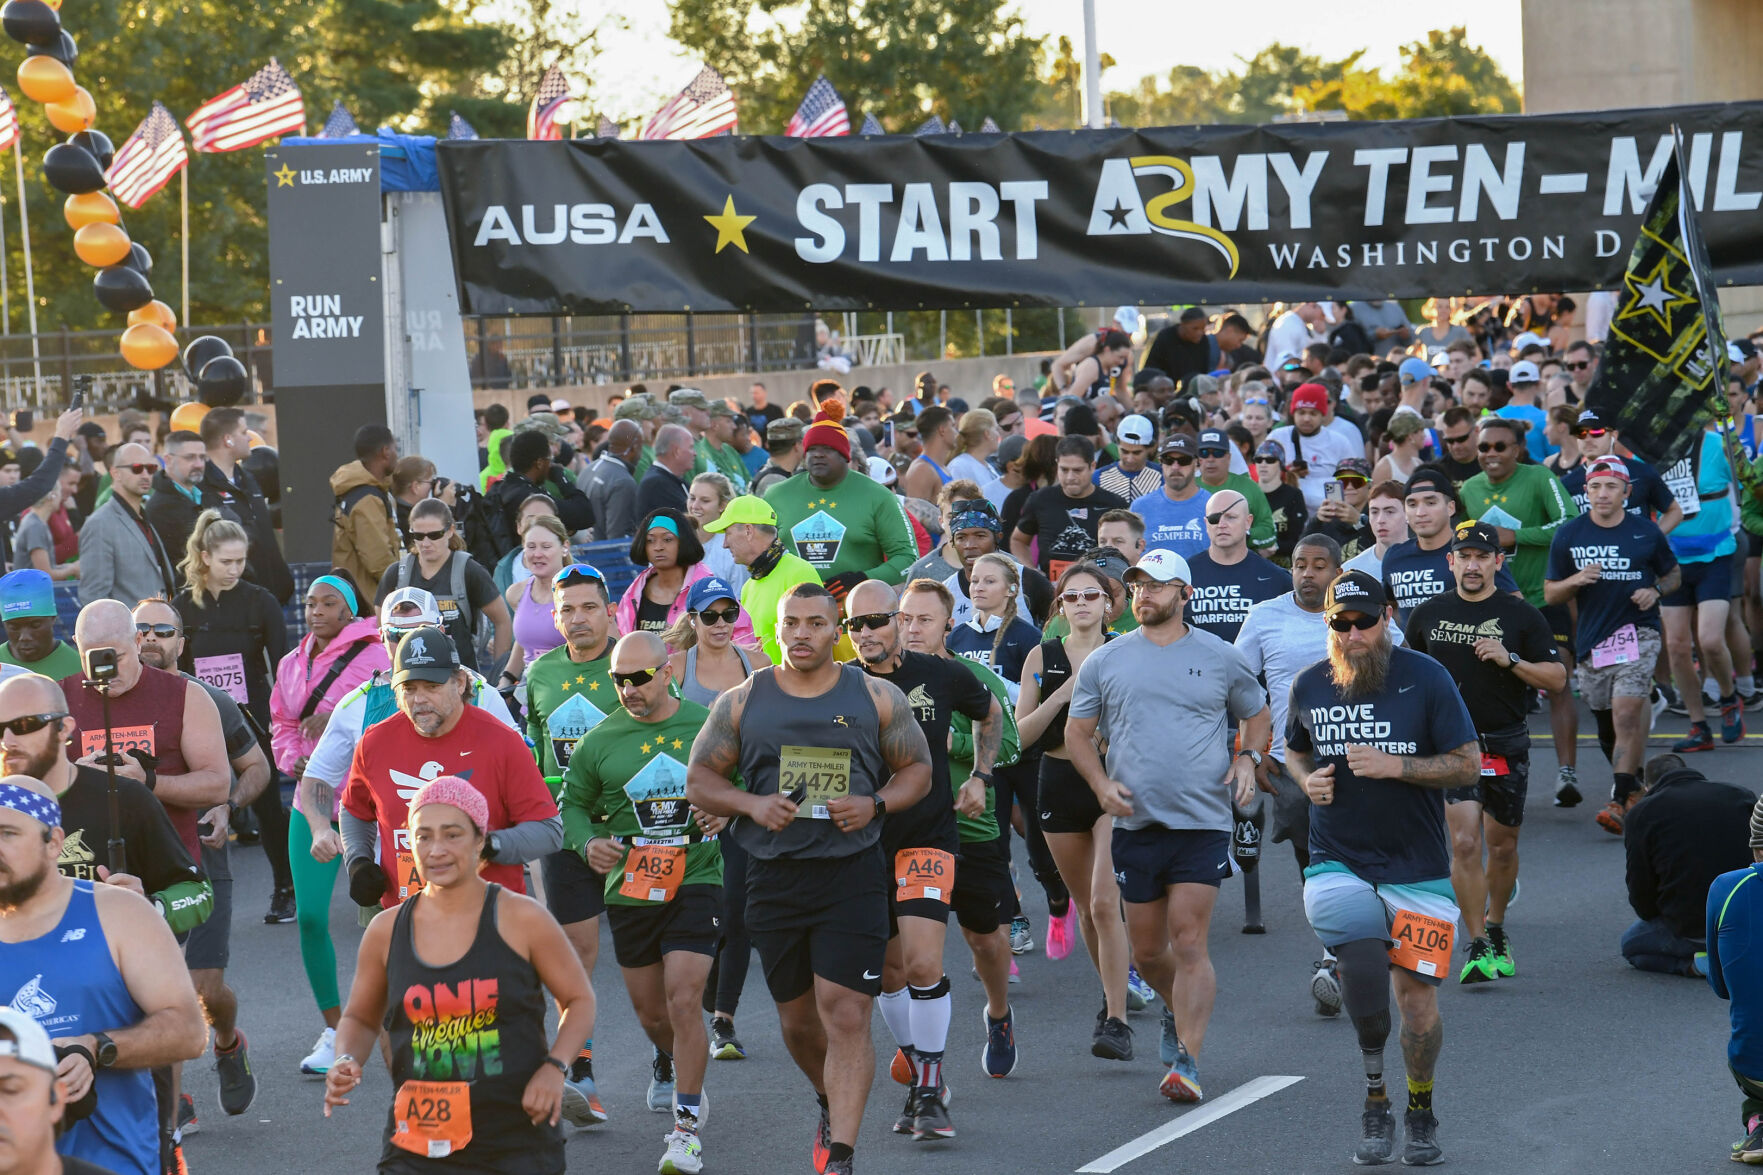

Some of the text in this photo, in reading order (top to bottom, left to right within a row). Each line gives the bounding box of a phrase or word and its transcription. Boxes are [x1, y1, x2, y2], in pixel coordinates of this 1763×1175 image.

[301, 167, 373, 185] U.S. ARMY
[473, 203, 671, 246] AUSA
[794, 180, 1049, 264] START
[1268, 235, 1567, 270] WASHINGTON
[290, 294, 341, 317] RUN
[292, 316, 364, 339] ARMY
[1152, 532, 1191, 542] SEMPER
[1392, 580, 1445, 598] UNITED
[1191, 598, 1253, 612] UNITED
[639, 619, 666, 630] TEAM
[1191, 613, 1249, 625] WARFIGHT
[1438, 620, 1476, 634] TEAM
[957, 650, 992, 664] OVE
[112, 729, 148, 740] TEN-MILER
[1315, 721, 1391, 741] UNITED
[787, 760, 845, 771] ARMY TEN-MILER
[781, 770, 847, 793] 24473
[635, 855, 675, 877] A83
[907, 858, 944, 876] A46
[1402, 913, 1422, 923] ARMY
[1397, 923, 1449, 951] A106
[403, 978, 499, 1025] ONE
[411, 1008, 498, 1051] Vieques
[411, 1028, 504, 1079] LOVE
[406, 1098, 452, 1123] A28
